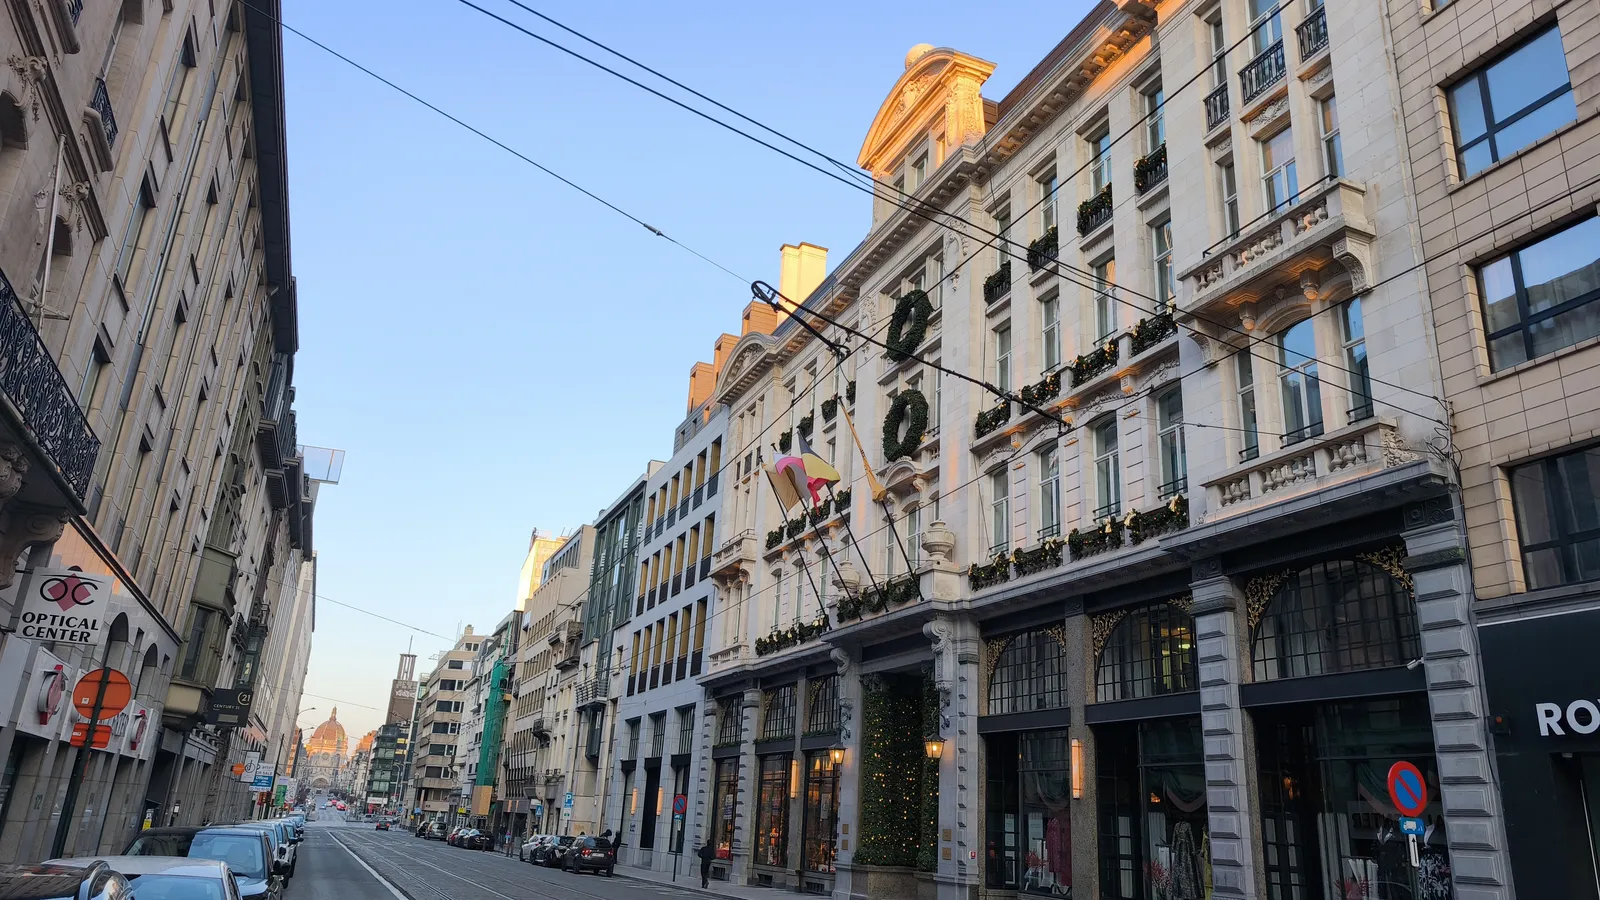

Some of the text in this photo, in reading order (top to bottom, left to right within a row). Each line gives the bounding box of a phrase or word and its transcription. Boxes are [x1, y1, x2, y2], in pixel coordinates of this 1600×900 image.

[22, 612, 99, 630] OPTICAL
[22, 625, 91, 642] CENTER
[1535, 698, 1600, 736] RO
[565, 794, 572, 803] P
